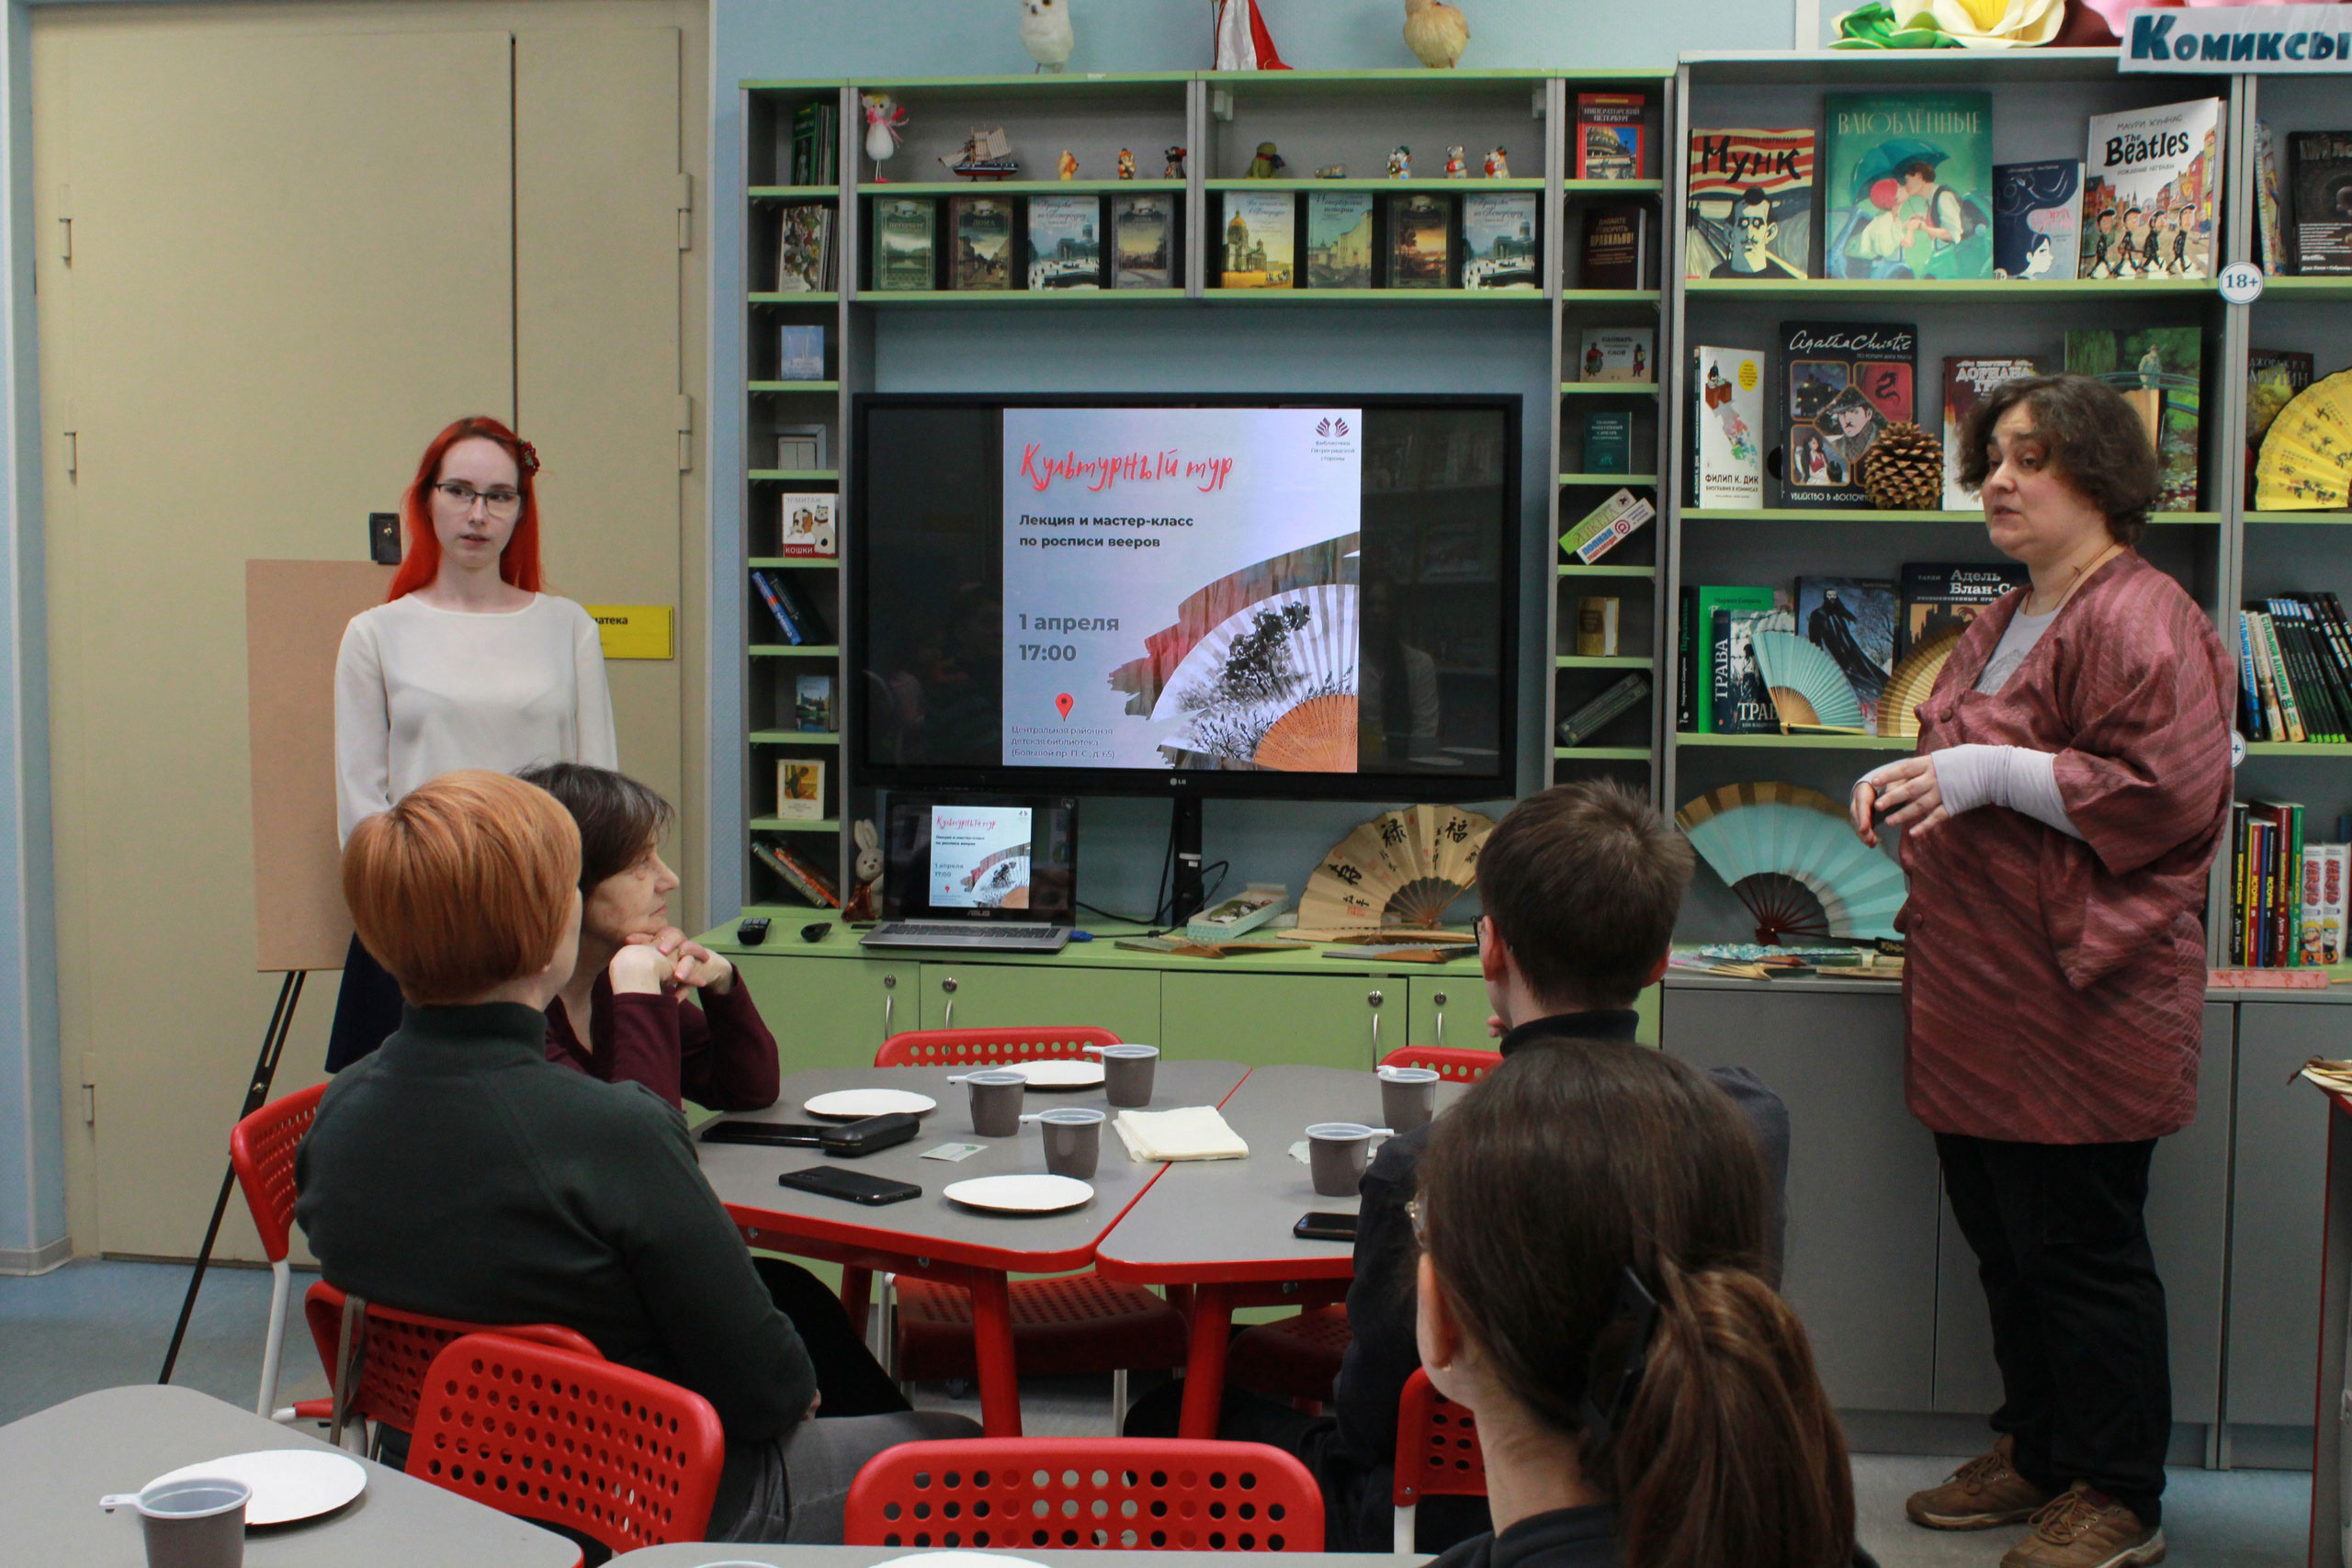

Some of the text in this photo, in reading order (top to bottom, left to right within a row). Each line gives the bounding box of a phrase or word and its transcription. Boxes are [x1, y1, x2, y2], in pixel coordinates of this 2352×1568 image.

[2131, 15, 2351, 62] Комиксы
[2124, 133, 2142, 143] The
[2103, 131, 2189, 167] Beatles
[2225, 274, 2259, 288] 18+
[1789, 330, 1912, 355] Agatha Christie
[1020, 443, 1234, 493] Культурный тур
[1704, 474, 1733, 484] ФИЛИП
[1743, 475, 1759, 485] ДИК
[1790, 491, 1825, 501] УБИЙСТВО
[1019, 514, 1194, 528] Лекция и мастер-класс
[1019, 537, 1161, 549] по росписи вееров
[1950, 569, 2001, 582] Адель
[1019, 614, 1120, 635] 1 апреля
[1019, 645, 1077, 661] 17:00
[1715, 638, 1729, 702] ТРАВА
[2261, 616, 2279, 658] СТАЛЬНОЙ
[2272, 657, 2290, 697] АЛХИМИК
[2281, 697, 2295, 710] 05
[1012, 725, 1114, 735] Центральная районная
[1012, 738, 1099, 746] детская библиотека
[2304, 858, 2322, 908] NARUTO
[2324, 858, 2341, 907] NARUTO
[2266, 876, 2274, 908] ИСТОРИЯ
